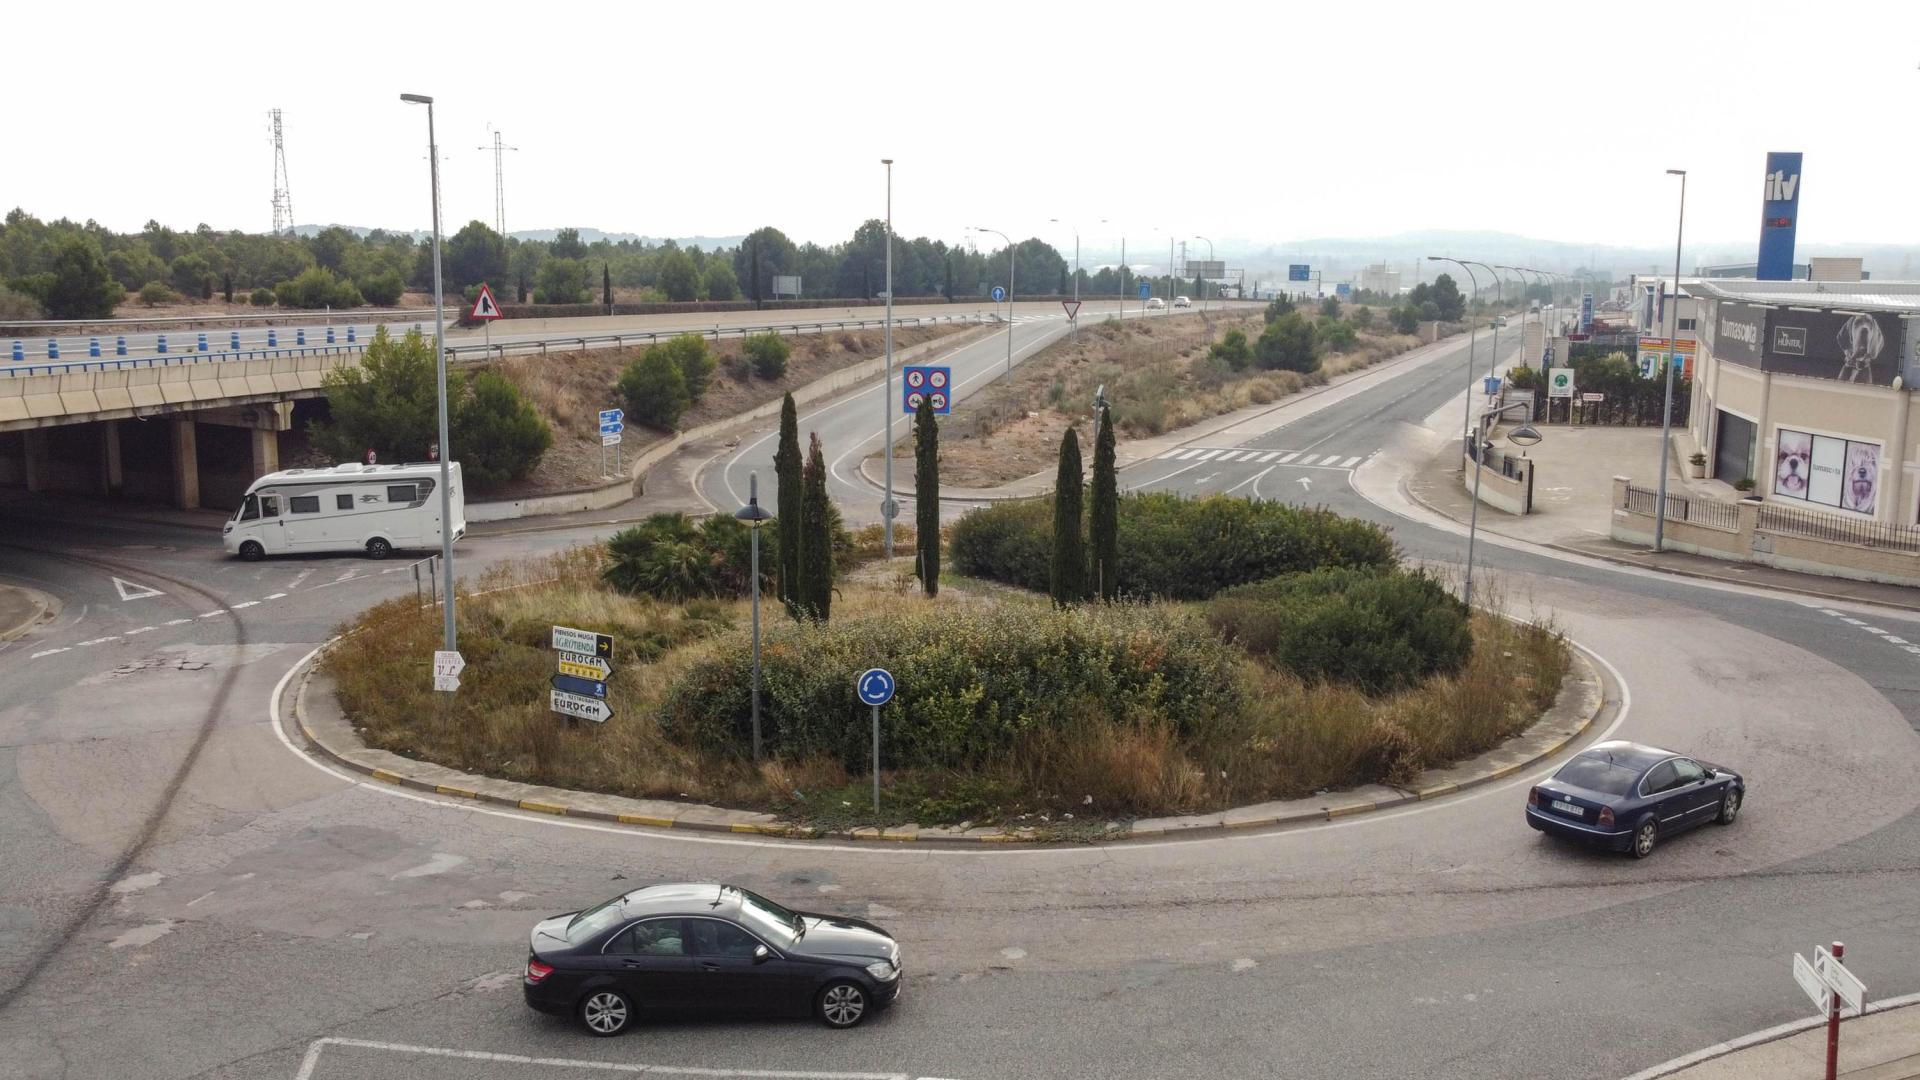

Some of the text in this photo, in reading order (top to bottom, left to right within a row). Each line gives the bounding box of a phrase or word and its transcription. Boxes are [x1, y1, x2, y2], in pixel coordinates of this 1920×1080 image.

[1765, 170, 1799, 201] itv
[554, 628, 577, 638] PIENSOS
[560, 651, 602, 667] EUROCAM
[554, 698, 600, 716] EUROCAM
